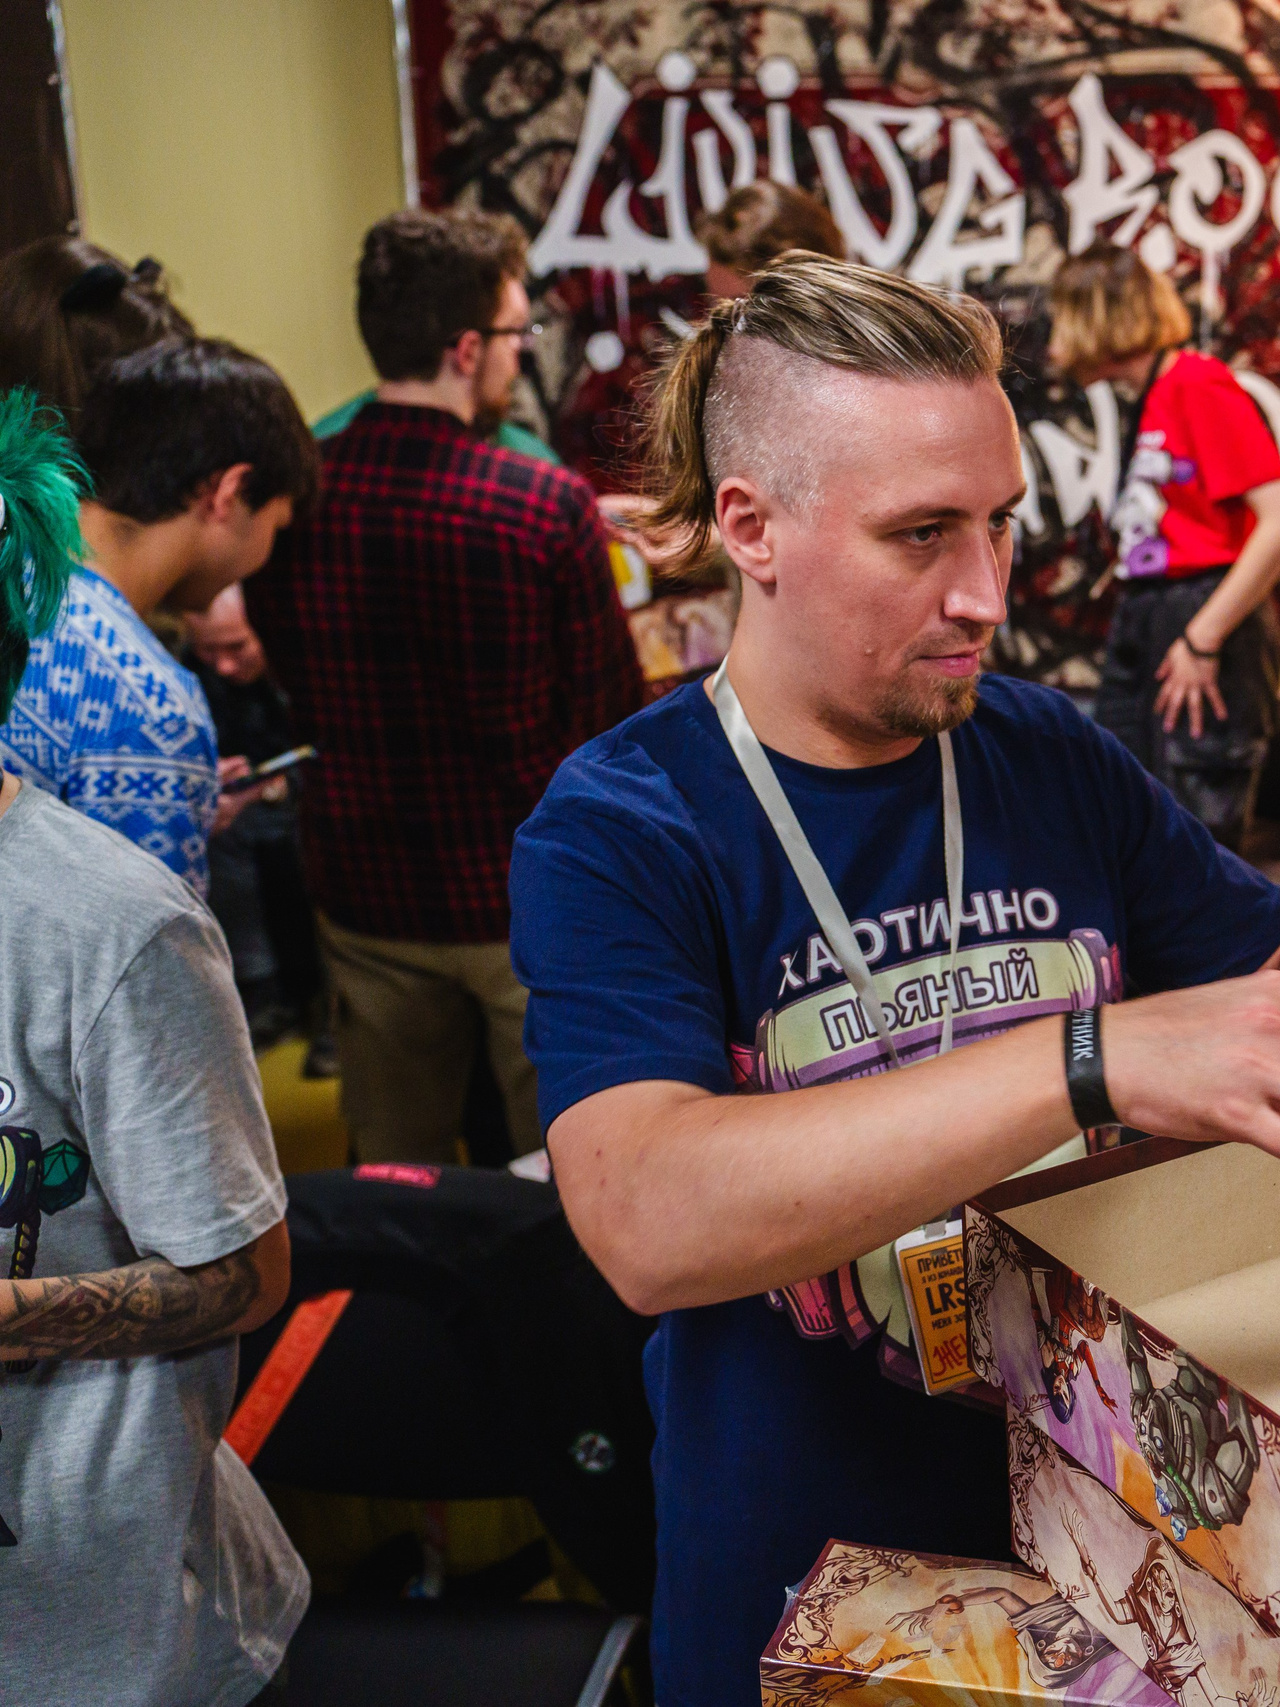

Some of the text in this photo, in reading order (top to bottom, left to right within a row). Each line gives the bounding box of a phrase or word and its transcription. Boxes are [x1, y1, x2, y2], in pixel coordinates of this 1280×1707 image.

[777, 887, 1060, 1000] ХАОТИЧНО
[819, 947, 1040, 1050] ПЬЯНЫЙ
[925, 1278, 966, 1316] LRS
